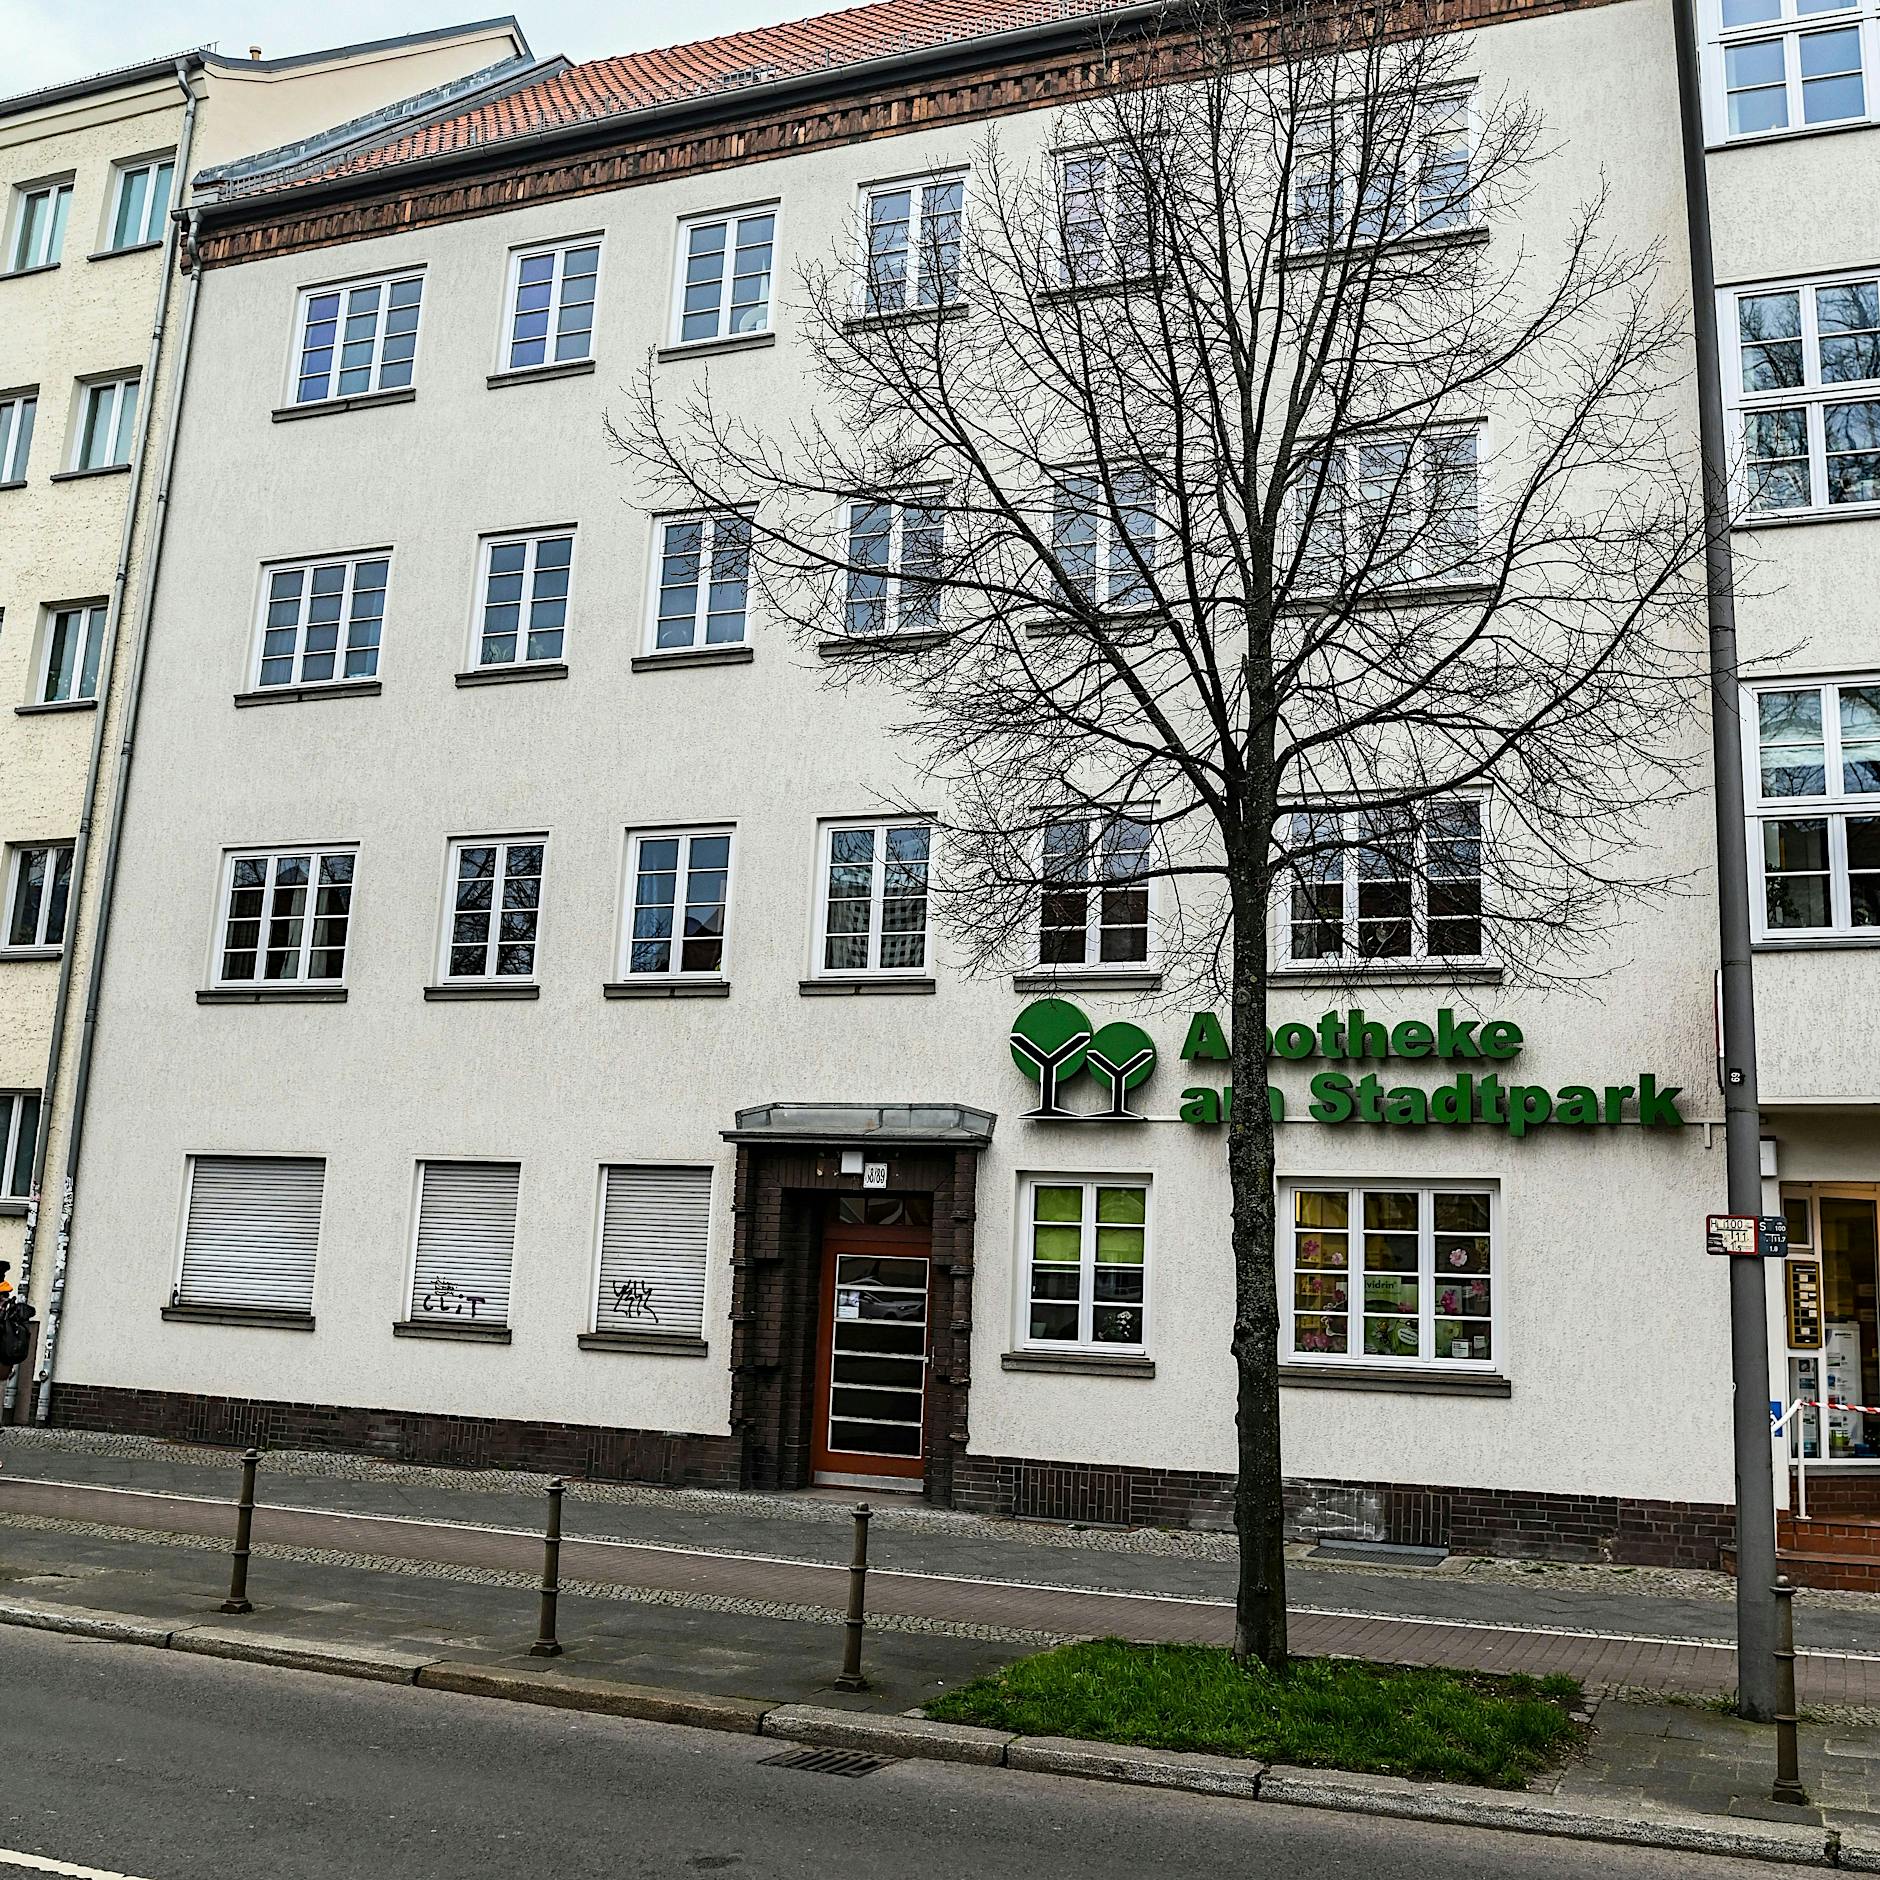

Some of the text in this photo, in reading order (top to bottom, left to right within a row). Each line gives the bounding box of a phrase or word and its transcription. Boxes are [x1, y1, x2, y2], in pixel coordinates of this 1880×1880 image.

[1180, 1008, 1524, 1060] Aotheke
[1308, 1072, 1685, 1137] Stadtpark
[1759, 1221, 1767, 1231] S
